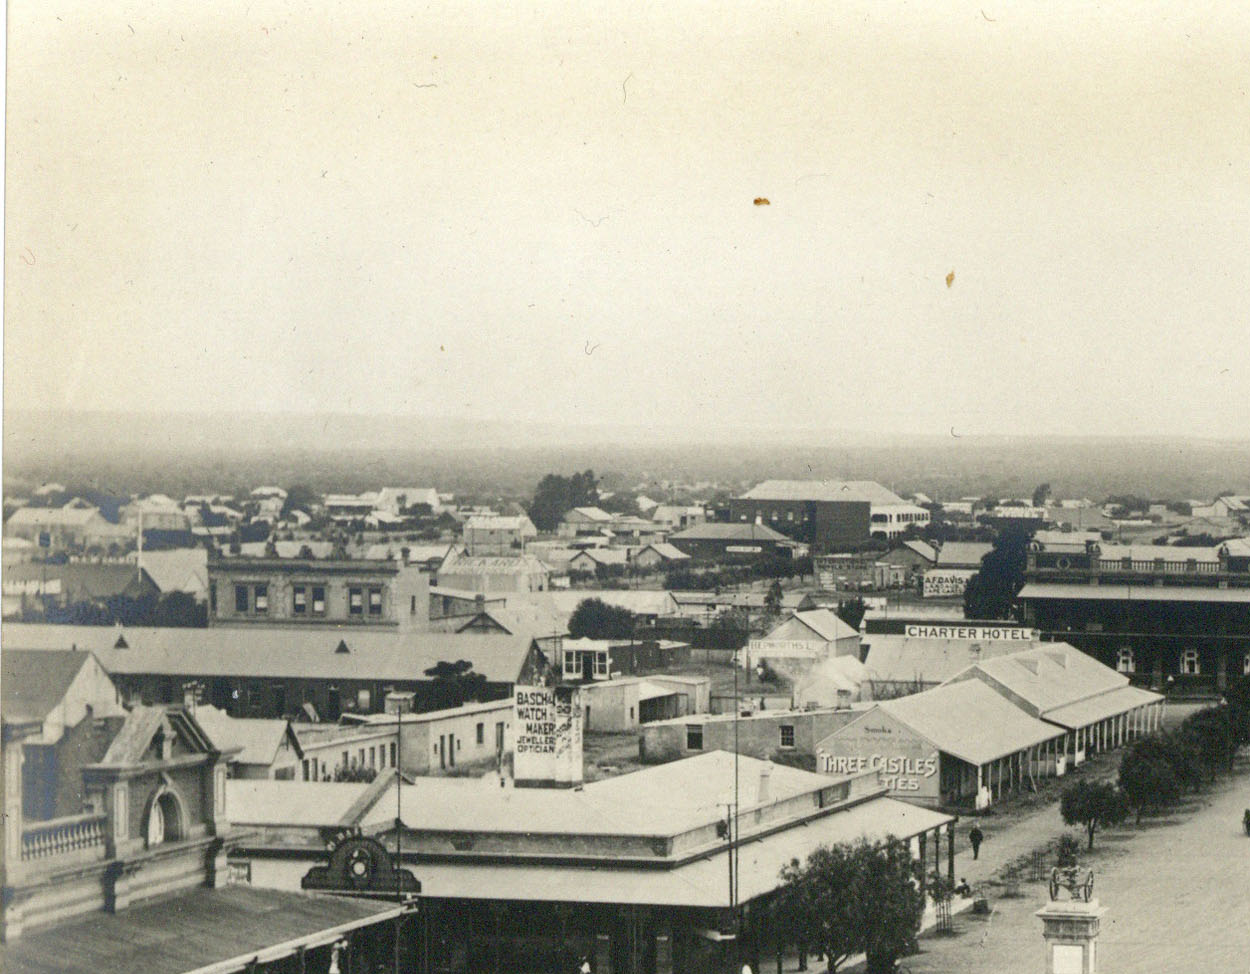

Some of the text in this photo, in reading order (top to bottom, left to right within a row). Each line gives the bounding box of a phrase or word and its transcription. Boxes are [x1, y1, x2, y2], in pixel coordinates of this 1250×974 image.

[908, 626, 1030, 640] CHARTER HOTEL
[517, 707, 547, 721] WATCH
[819, 753, 937, 778] THREE CASTLES
[879, 775, 920, 791] TTES
